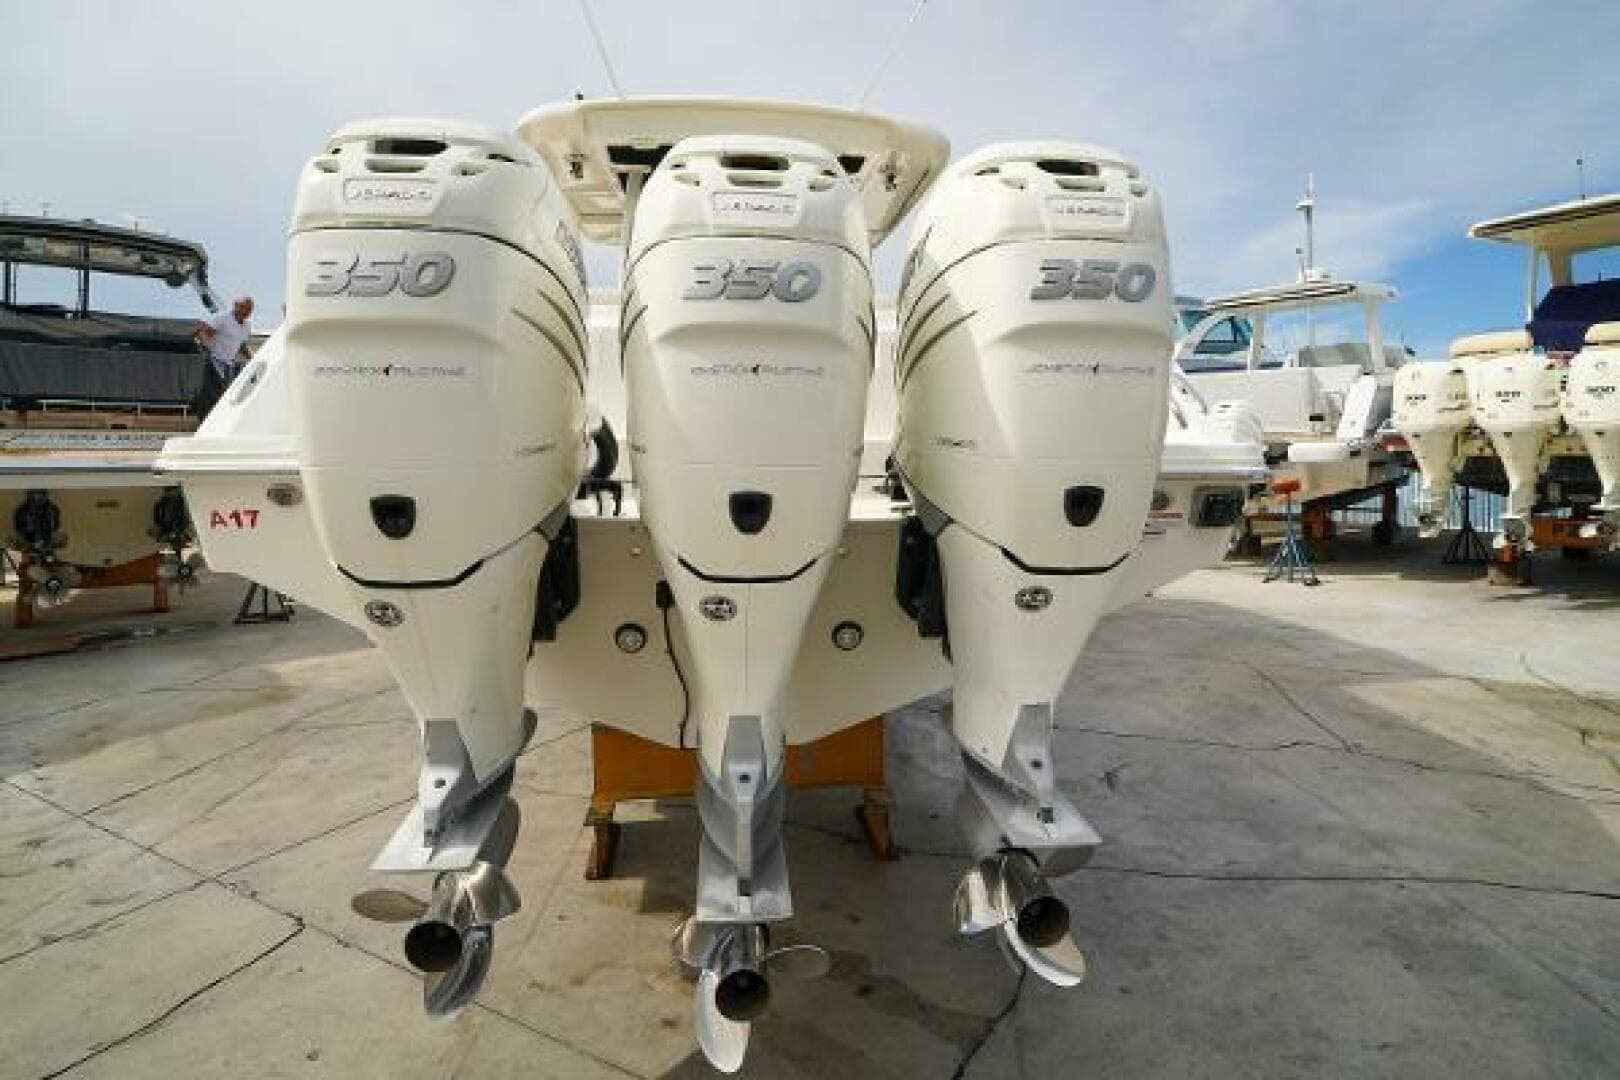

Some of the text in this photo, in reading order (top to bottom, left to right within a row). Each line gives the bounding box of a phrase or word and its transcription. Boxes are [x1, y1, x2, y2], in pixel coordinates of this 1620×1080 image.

[305, 251, 456, 297] 350
[682, 257, 822, 303] 350
[1030, 258, 1156, 302] 350
[210, 508, 260, 529] A17
